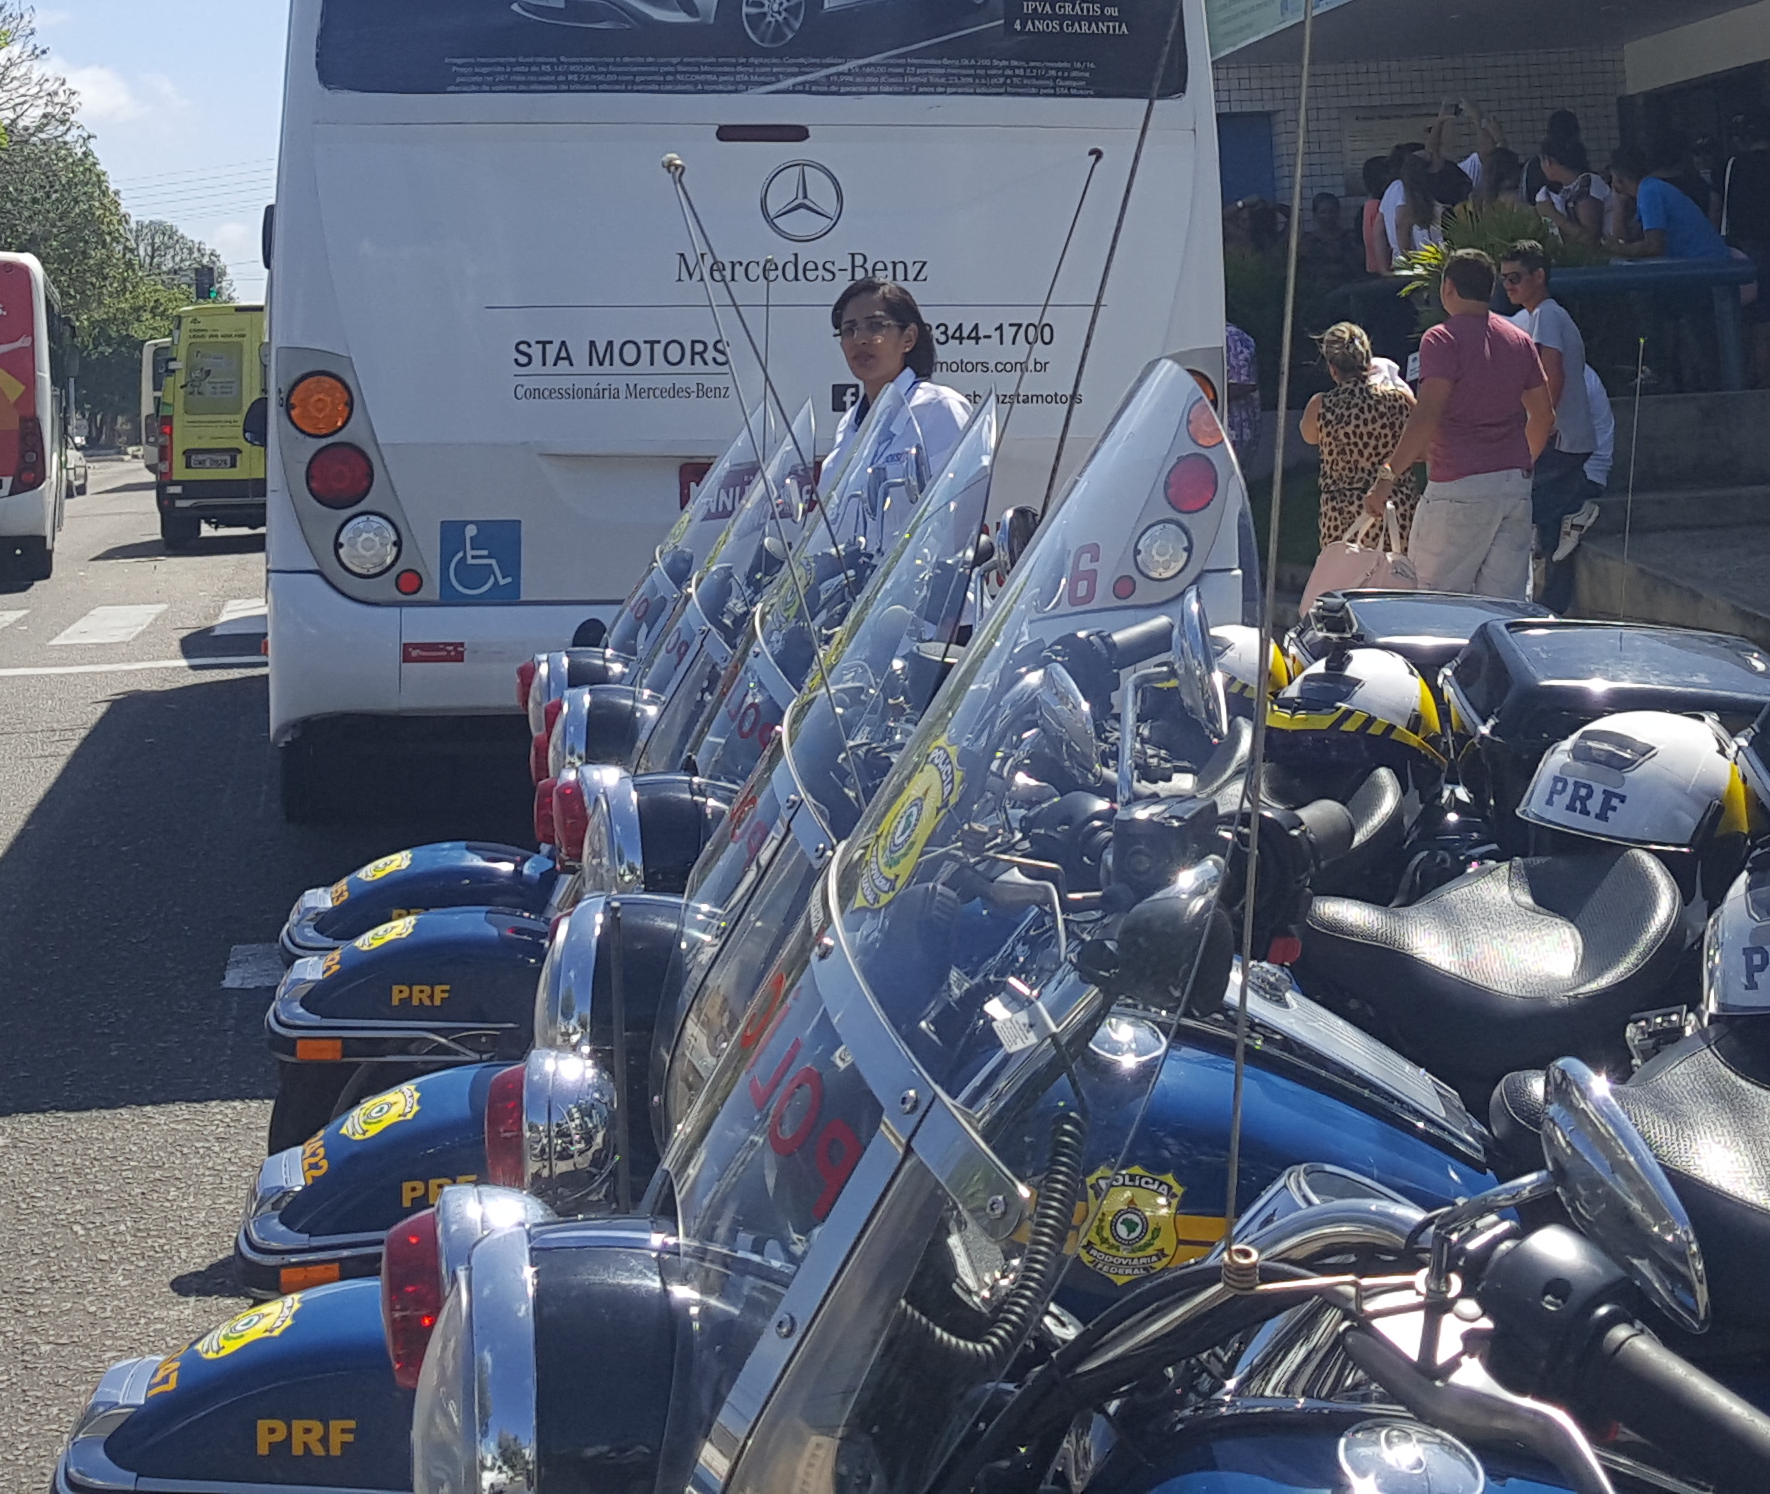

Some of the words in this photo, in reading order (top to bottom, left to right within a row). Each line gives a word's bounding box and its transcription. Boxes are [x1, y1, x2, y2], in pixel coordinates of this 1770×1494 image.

[1023, 1, 1052, 14] IPVA
[1055, 0, 1101, 16] GRÁTIS
[1104, 7, 1119, 16] ou
[1014, 19, 1021, 31] 4
[1025, 20, 1060, 32] ANOS
[1063, 20, 1129, 35] GARANTIA
[675, 252, 929, 283] Mercedes-Benz
[925, 322, 1055, 346] 344-1700
[513, 339, 574, 368] STA
[587, 337, 730, 368] MOTORS
[933, 358, 1051, 373] motors.com.br
[513, 383, 621, 401] Concessionária
[624, 382, 730, 400] Mercedes-Benz
[1545, 775, 1627, 823] PRF
[391, 984, 450, 1006] PRF
[402, 1174, 478, 1208] PR
[1090, 1249, 1158, 1265] RODOVIÁRIA
[1097, 1264, 1147, 1275] FEDERAL
[256, 1420, 357, 1456] PRF
